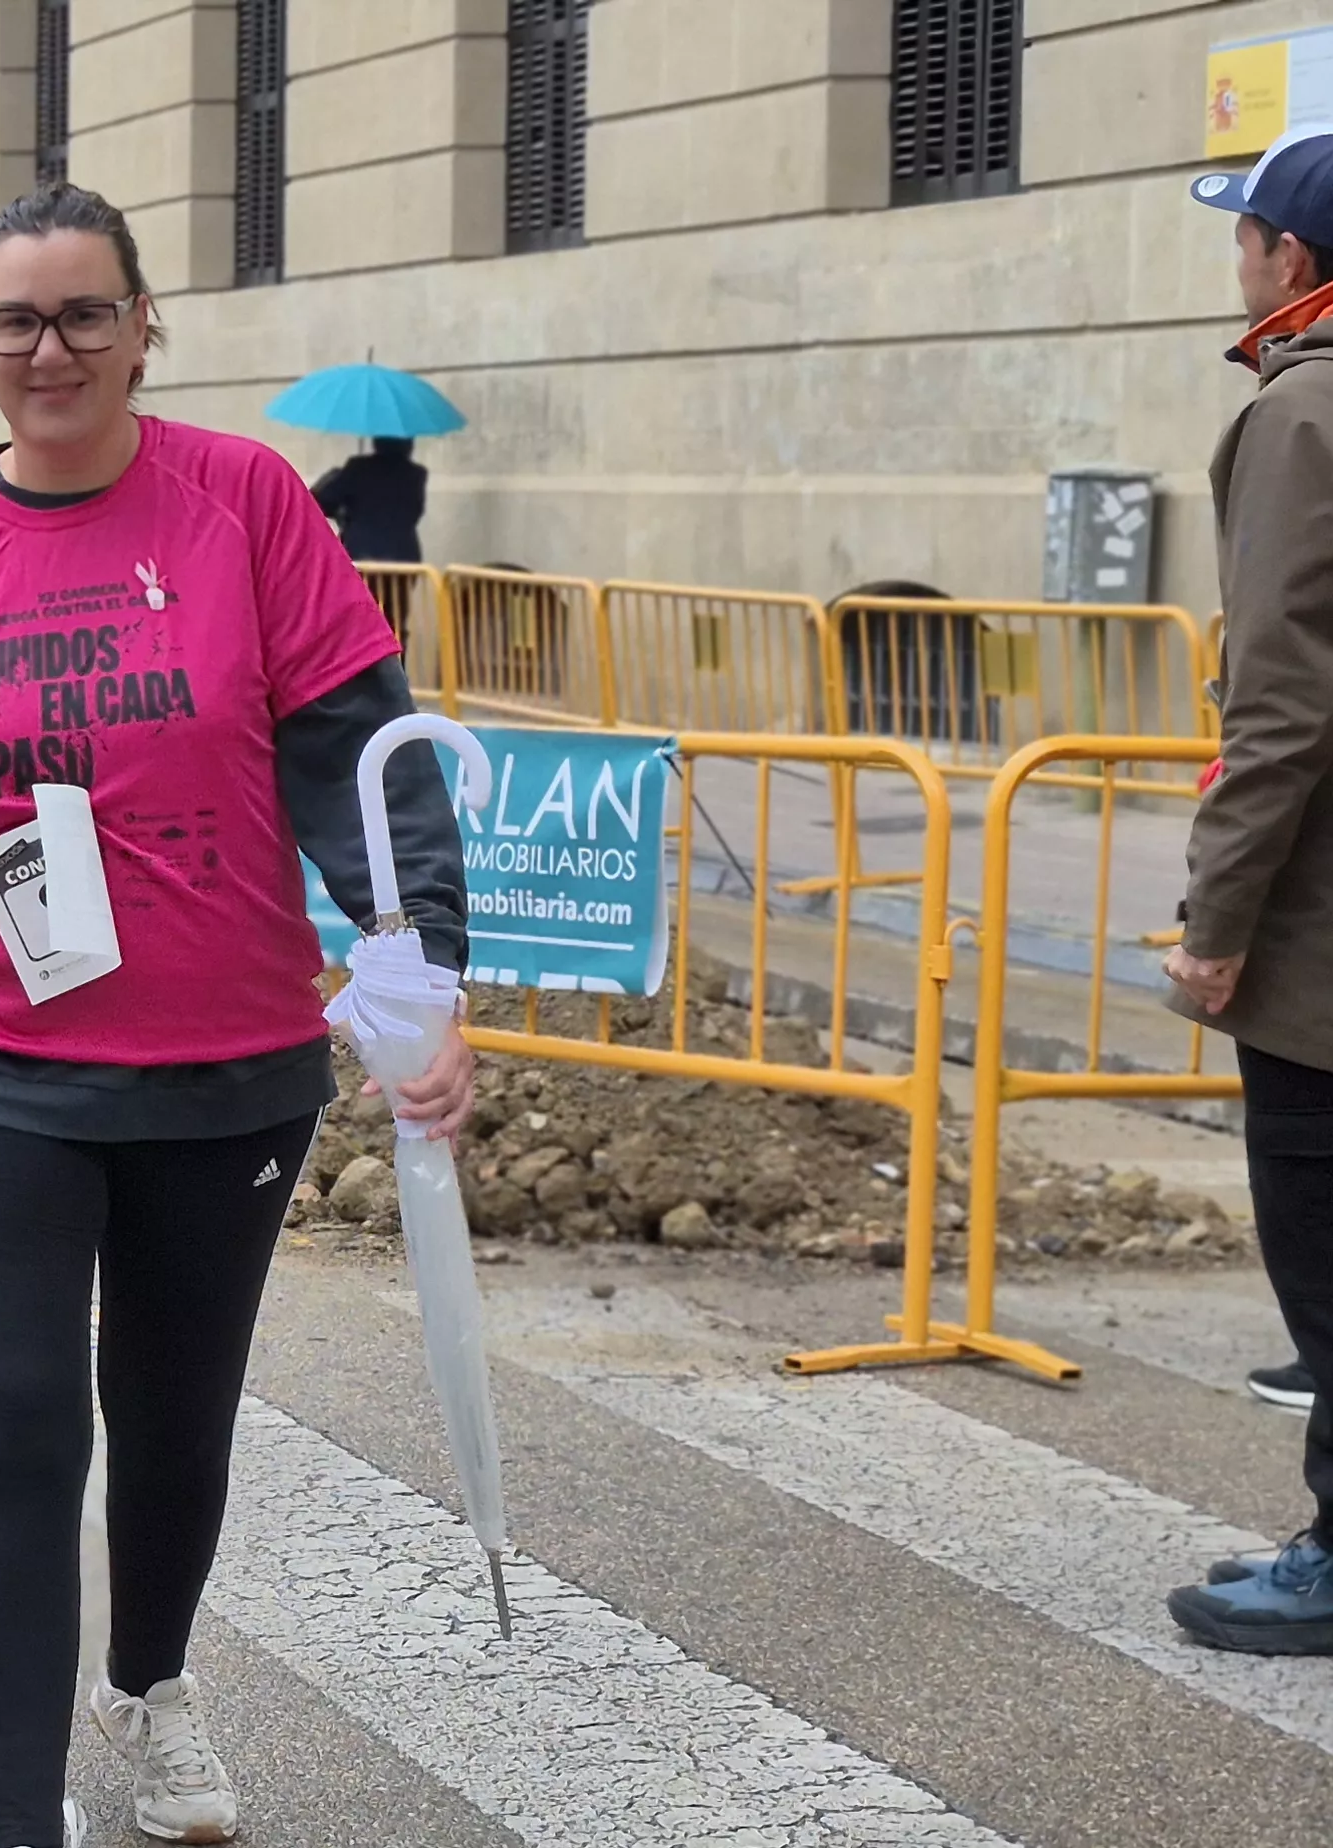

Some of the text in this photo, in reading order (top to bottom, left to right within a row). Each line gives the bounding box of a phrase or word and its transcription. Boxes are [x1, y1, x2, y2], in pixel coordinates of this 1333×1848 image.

[43, 602, 103, 619] CONTRA
[40, 668, 197, 732] EN CADA
[452, 753, 648, 843] RLAN
[5, 858, 45, 885] CON
[463, 840, 638, 882] NMOBILIARIOS
[467, 888, 632, 926] mobiliaria.com
